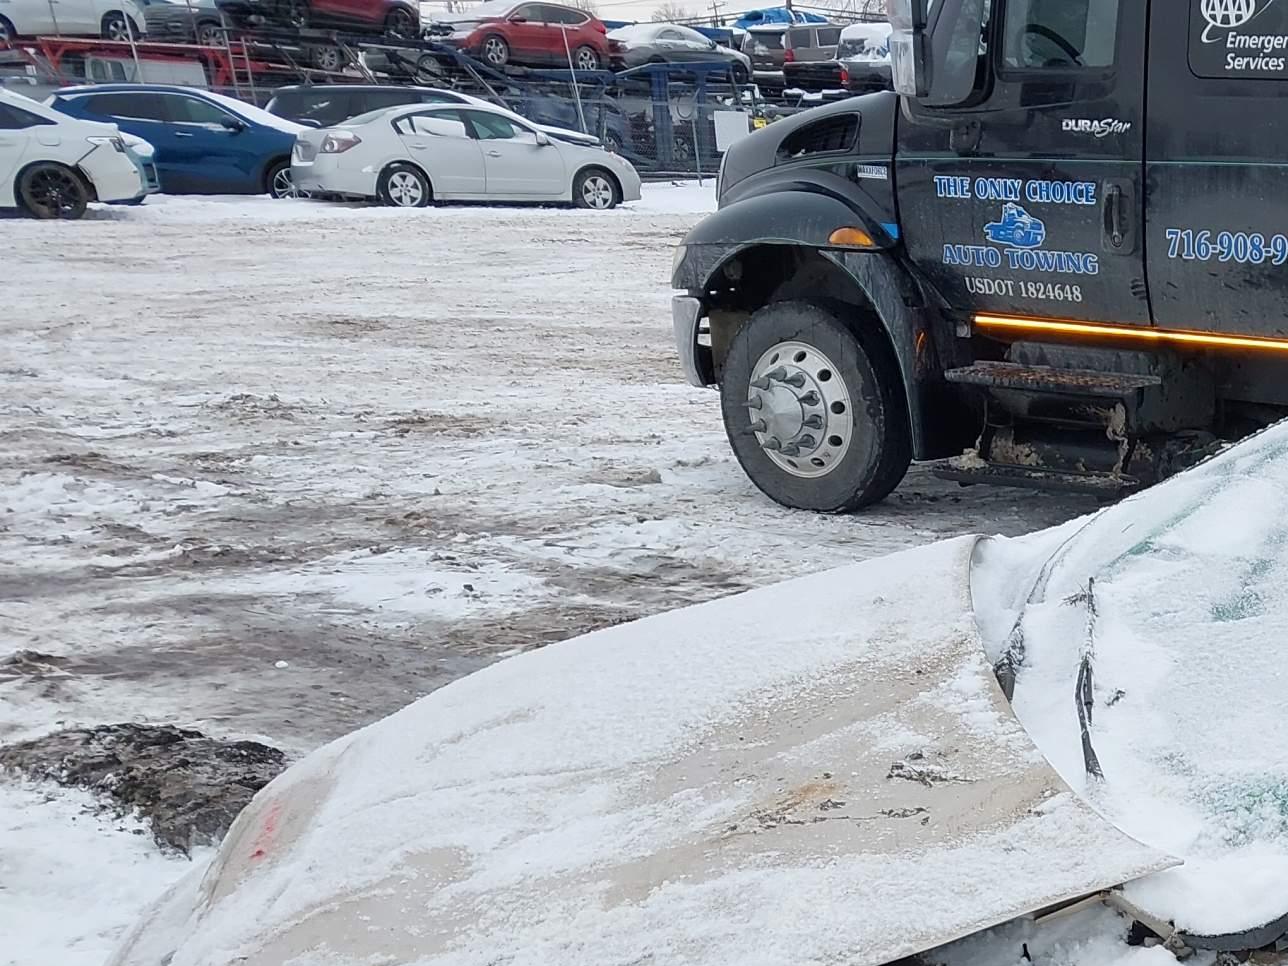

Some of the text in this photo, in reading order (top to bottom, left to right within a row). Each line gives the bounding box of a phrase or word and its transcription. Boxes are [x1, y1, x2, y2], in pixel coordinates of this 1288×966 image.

[1207, 0, 1248, 25] AAA
[1225, 53, 1285, 70] Services
[934, 176, 1096, 204] THE ONLY CHOICE
[943, 244, 1098, 274] AUTO TOWING
[965, 277, 1082, 302] USDOT 1824648
